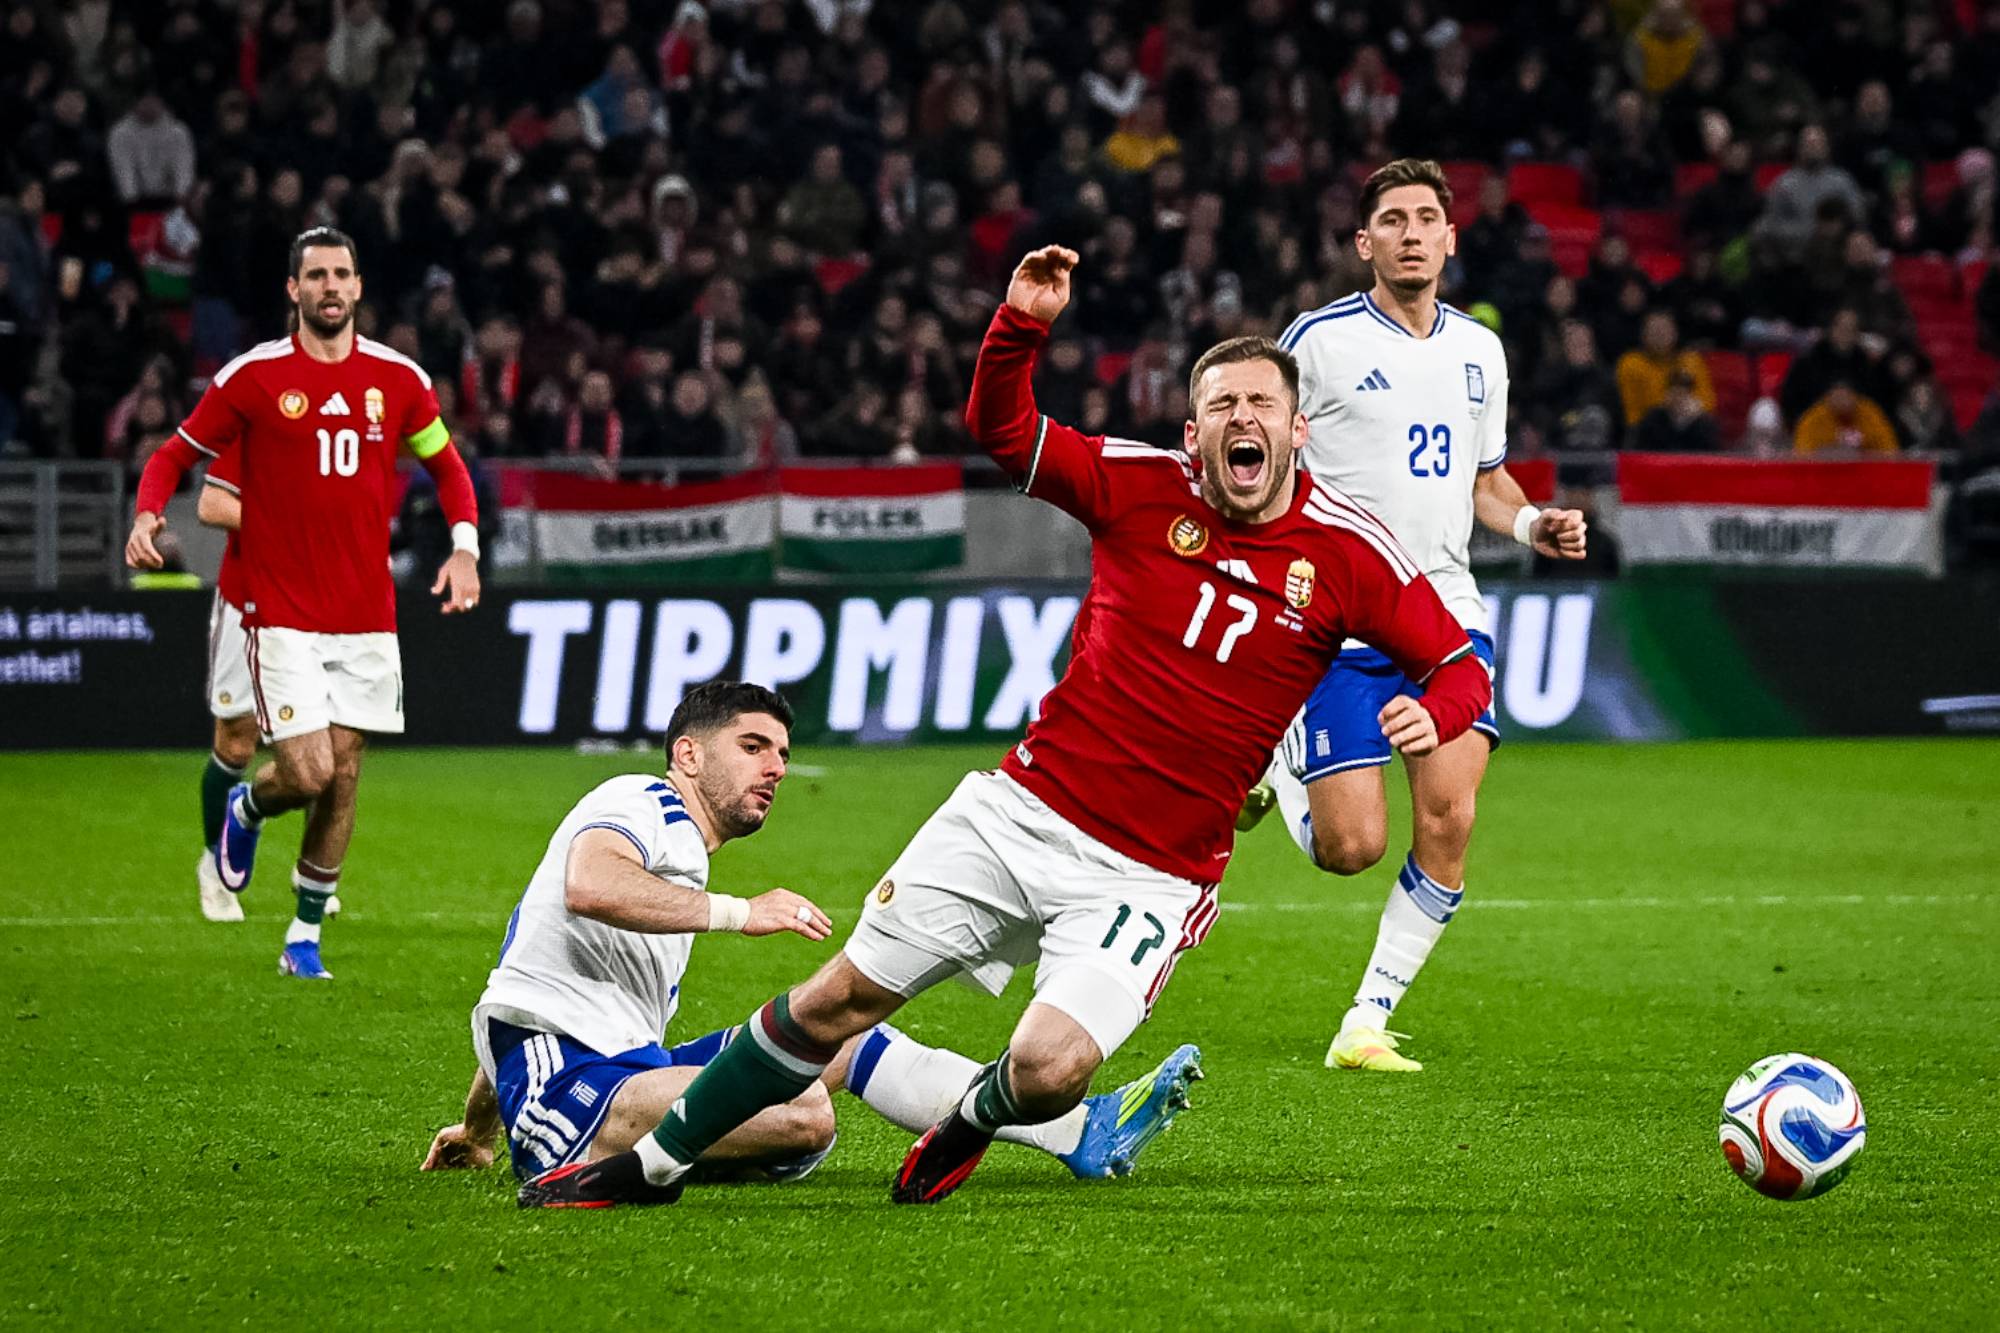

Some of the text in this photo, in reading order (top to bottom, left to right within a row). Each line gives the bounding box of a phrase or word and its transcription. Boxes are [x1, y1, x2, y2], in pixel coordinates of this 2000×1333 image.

[316, 428, 359, 477] 10
[1408, 424, 1451, 477] 23
[1182, 581, 1258, 663] 17
[508, 597, 1082, 733] TIPPMIX
[1100, 904, 1165, 966] 17
